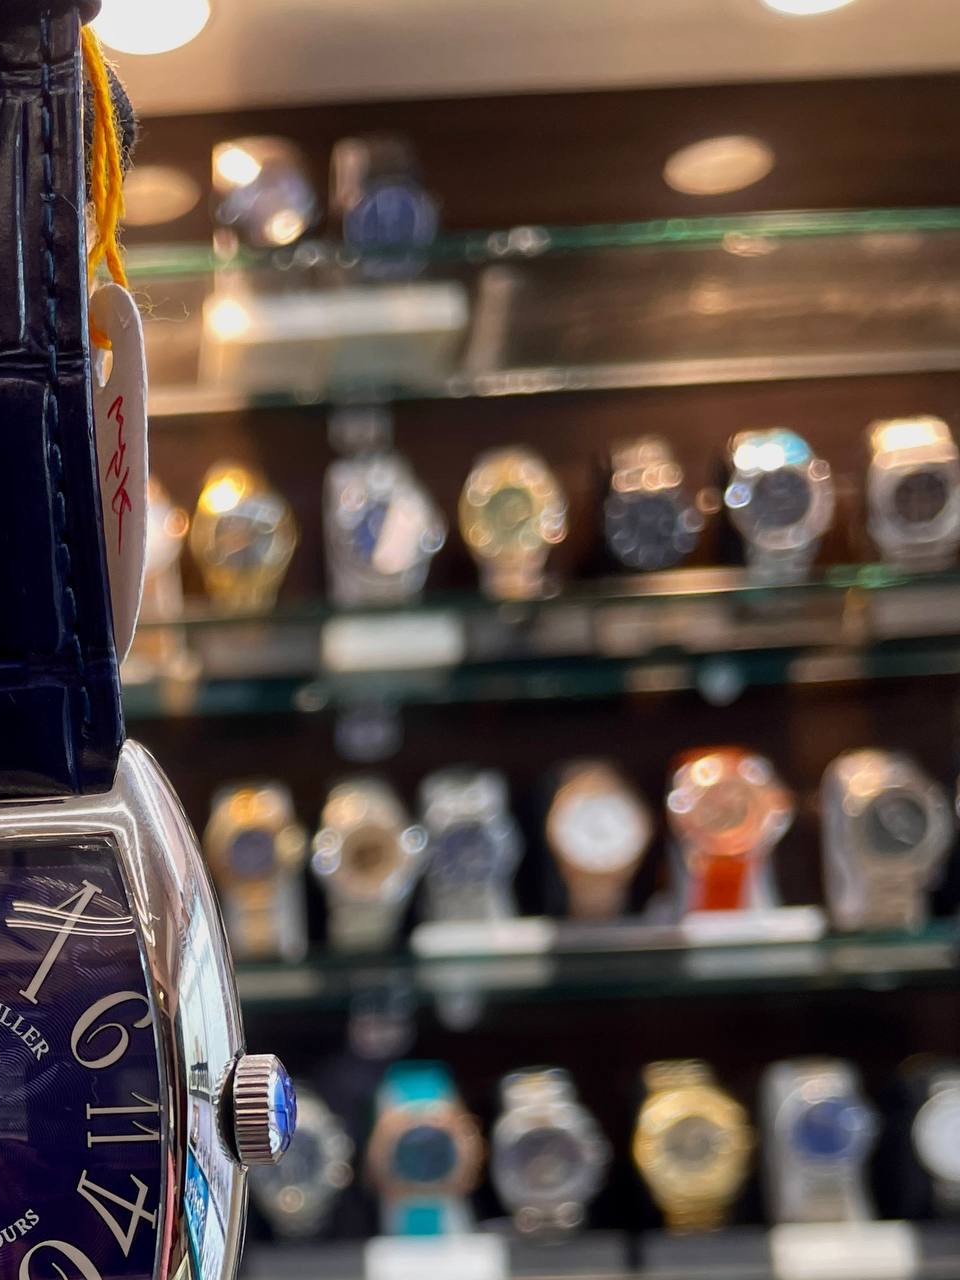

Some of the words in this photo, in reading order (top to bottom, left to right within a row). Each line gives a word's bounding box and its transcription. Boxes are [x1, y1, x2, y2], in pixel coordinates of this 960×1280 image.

[18, 879, 103, 1005] 1
[70, 990, 153, 1069] 6
[86, 1091, 164, 1148] 11
[76, 1169, 158, 1258] 4
